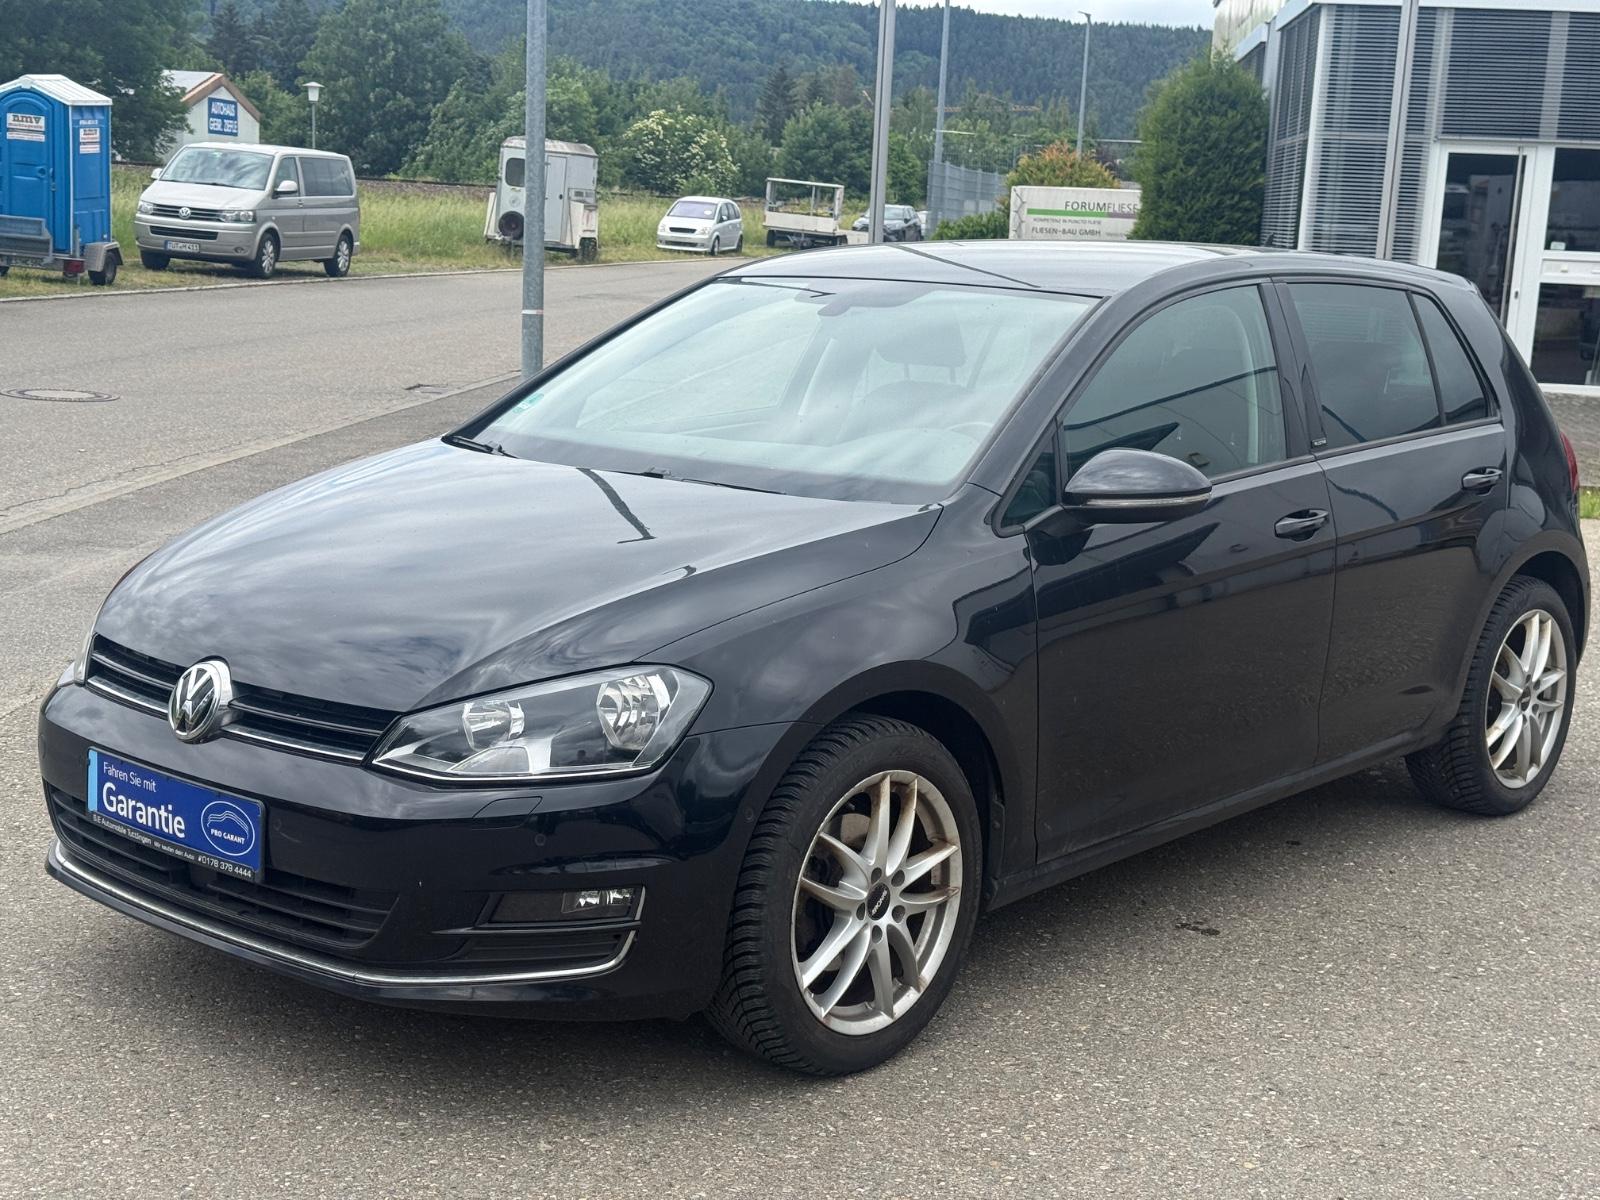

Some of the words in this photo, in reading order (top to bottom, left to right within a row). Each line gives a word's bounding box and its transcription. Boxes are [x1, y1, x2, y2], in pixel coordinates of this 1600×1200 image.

[211, 101, 236, 116] AUTOHAUS
[12, 114, 42, 125] nmv
[1032, 226, 1077, 236] FLIESEN-BAU
[1079, 228, 1101, 237] GMBH
[103, 761, 129, 782] Fahren
[129, 771, 142, 787] Sie
[143, 779, 157, 792] mit
[102, 781, 186, 838] Garantie
[210, 828, 222, 838] PRO
[222, 833, 246, 845] GARANT
[234, 866, 252, 878] 4444
